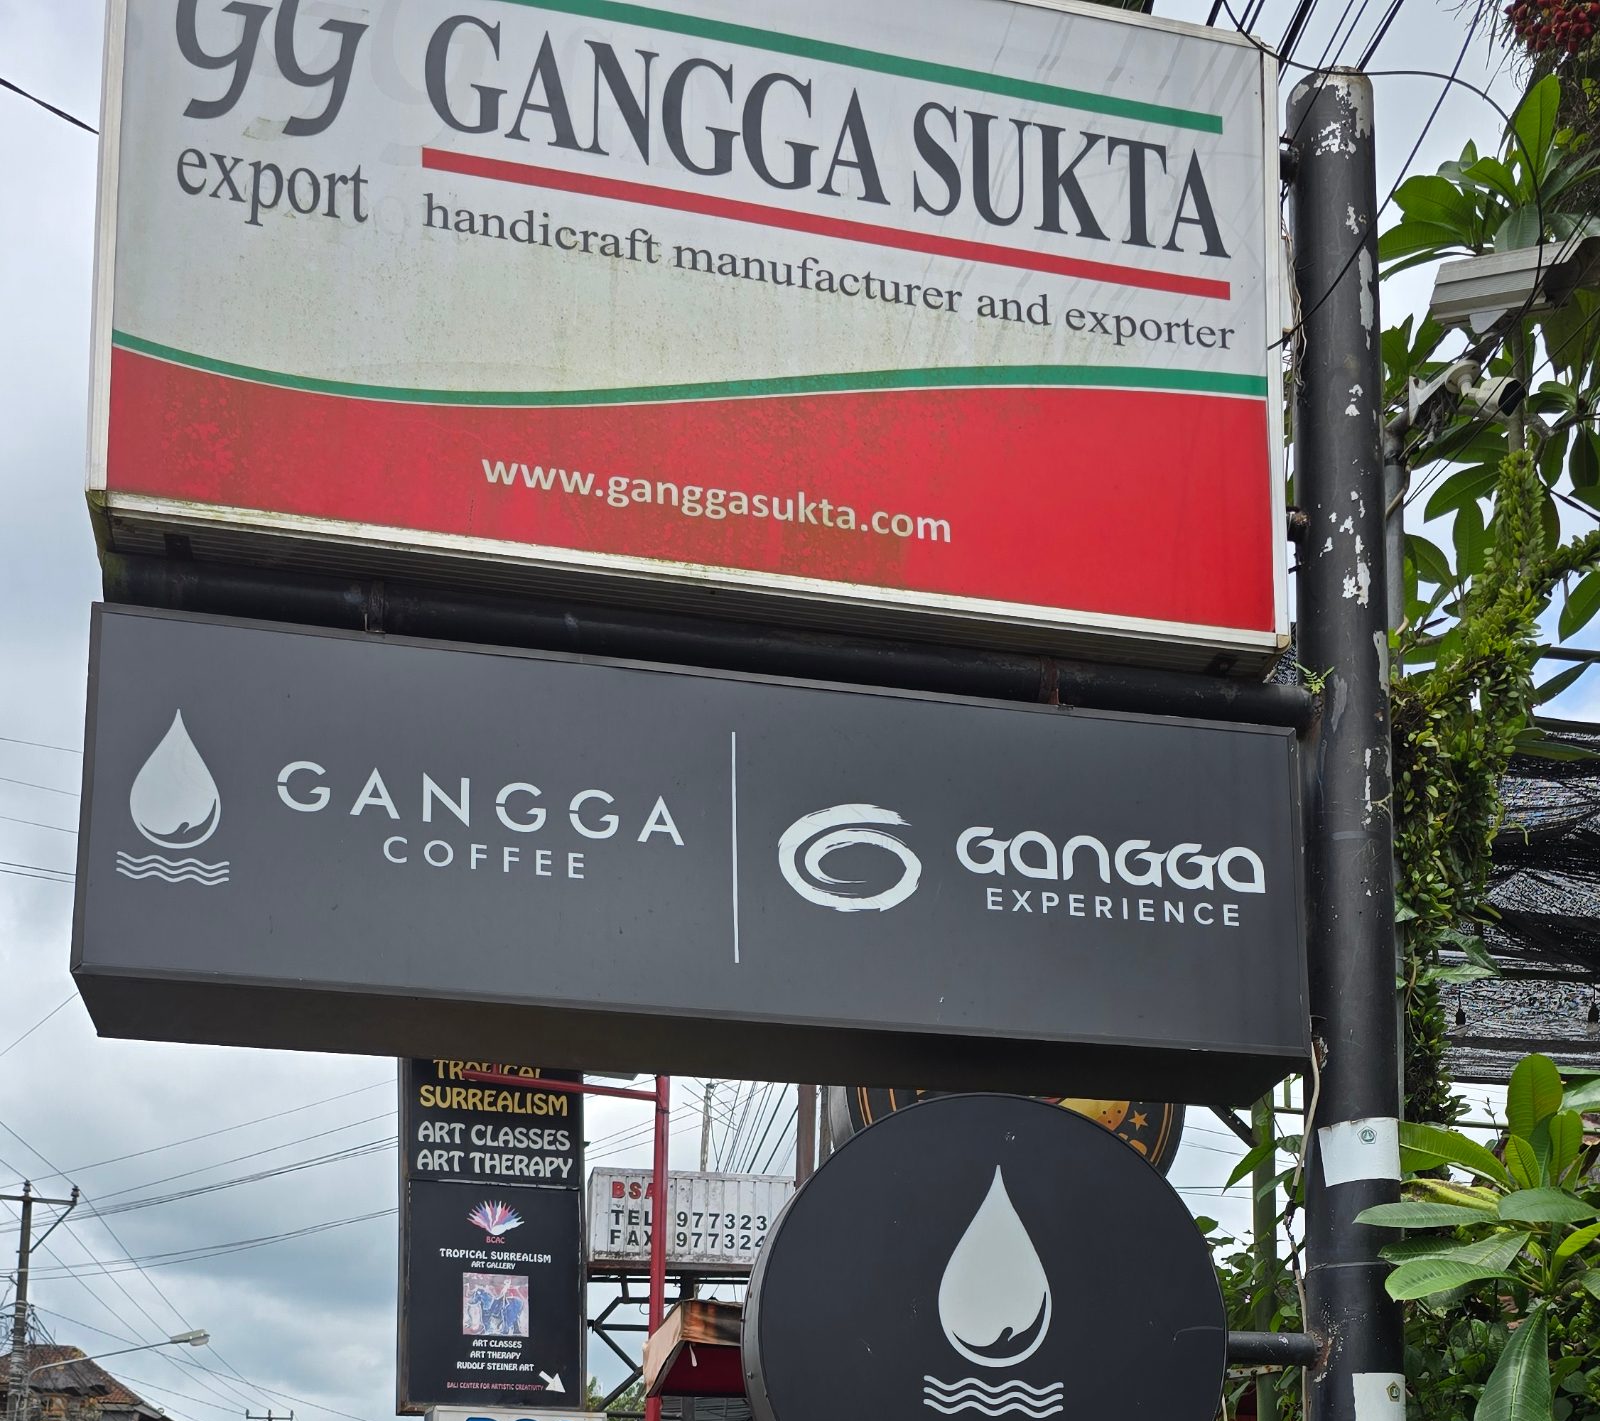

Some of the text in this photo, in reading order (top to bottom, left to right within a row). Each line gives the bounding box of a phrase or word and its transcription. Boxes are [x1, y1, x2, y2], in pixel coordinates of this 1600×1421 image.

[424, 14, 1231, 259] GANGGA SUKTA
[176, 145, 370, 227] export
[422, 192, 1235, 351] handicraft manufacturer and exporter
[481, 457, 952, 544] www.ganggasukta.com
[276, 760, 685, 846] GANGGA
[382, 835, 586, 880] COFFEE
[987, 886, 1241, 927] EXPERIENCE
[433, 1059, 541, 1082] TROCA
[419, 1084, 568, 1117] SURREALISM
[417, 1120, 571, 1151] ART CLASSES
[416, 1149, 573, 1179] ART THERAPY
[676, 1211, 768, 1231] 977323
[486, 1236, 505, 1245] BCAC
[676, 1232, 766, 1250] 977324
[439, 1248, 552, 1264] TROPICAL SURREALISM
[471, 1260, 516, 1270] ART GALLERY
[470, 1351, 521, 1360] ART THERAPY
[472, 1339, 523, 1349] ART CLASSES
[456, 1361, 535, 1372] RUDOLF STEINER ART
[446, 1381, 459, 1389] BALI
[480, 1382, 491, 1390] FOR
[491, 1383, 514, 1391] ARTISTIC
[516, 1383, 544, 1391] CREATIVITY
